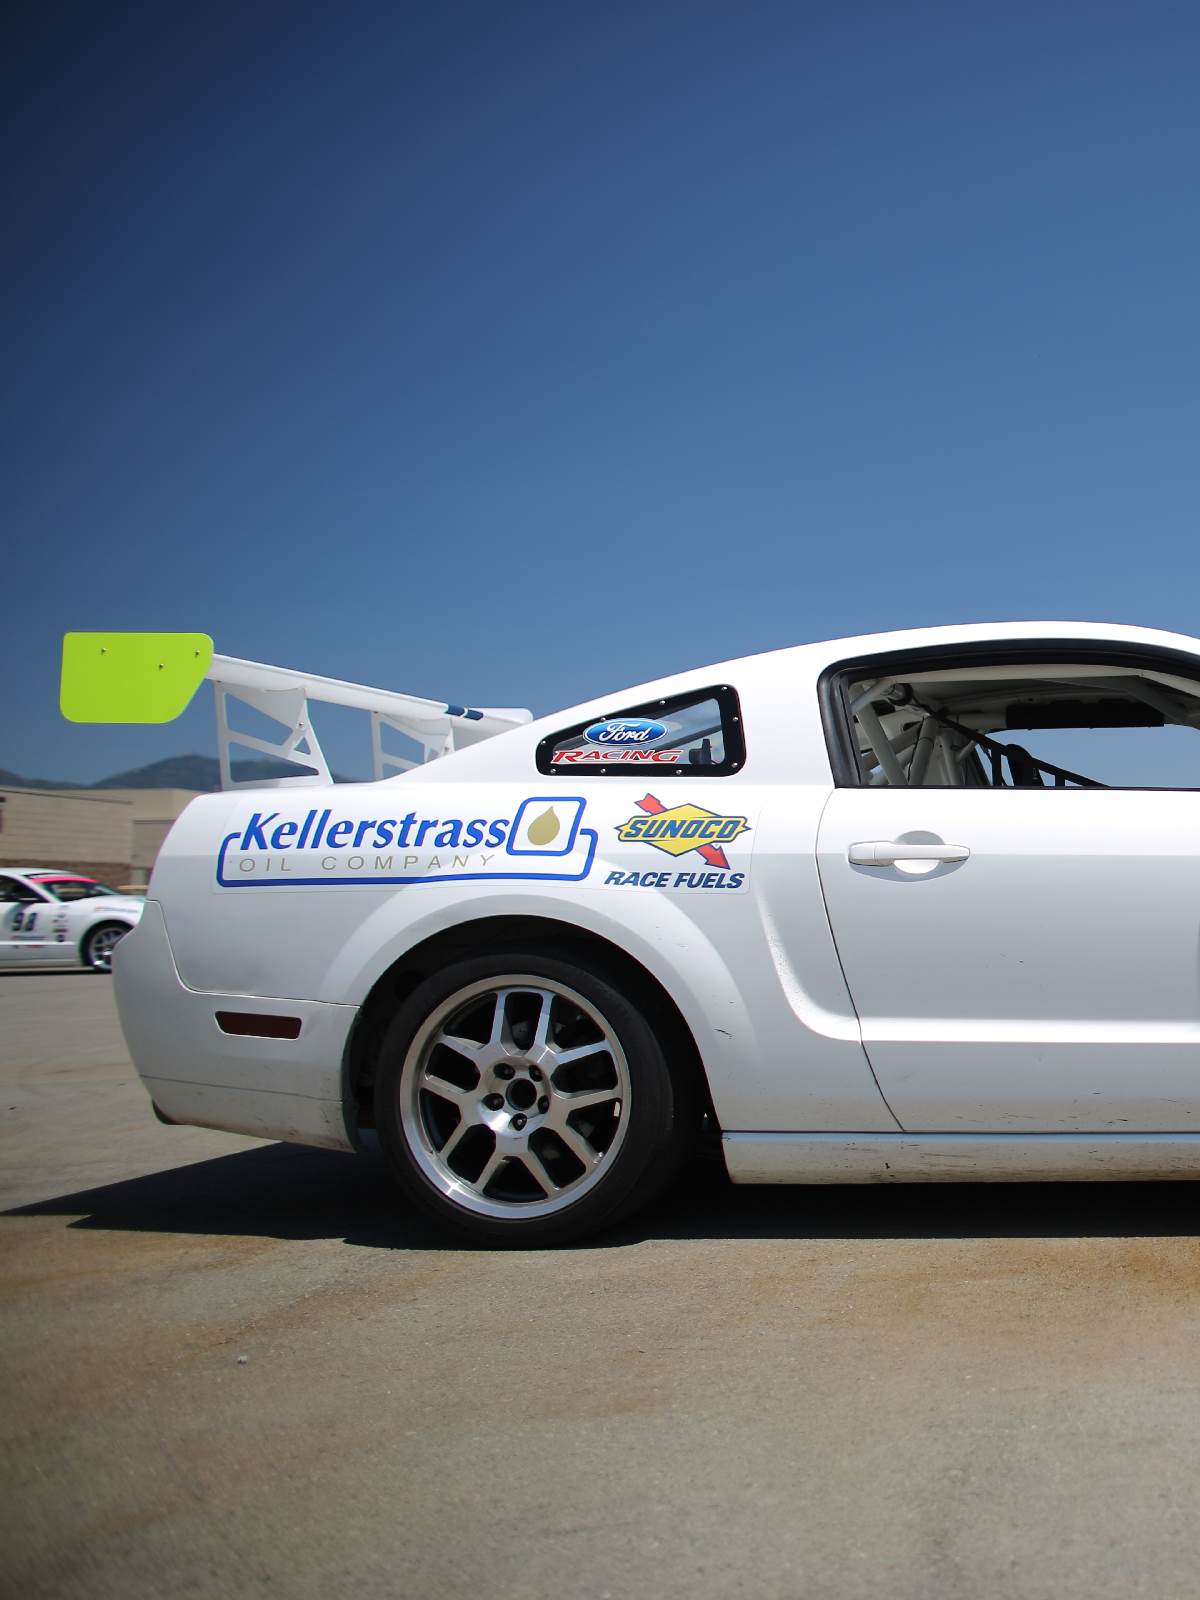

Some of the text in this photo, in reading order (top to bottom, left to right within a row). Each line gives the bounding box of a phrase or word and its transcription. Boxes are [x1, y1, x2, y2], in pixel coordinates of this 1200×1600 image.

[599, 722, 653, 742] Ford
[552, 750, 684, 764] RACING
[240, 809, 510, 851] Kellerstrass
[624, 819, 742, 839] SUNOCO
[239, 854, 495, 872] OIL COMPANY
[604, 871, 745, 889] RACE FUELS
